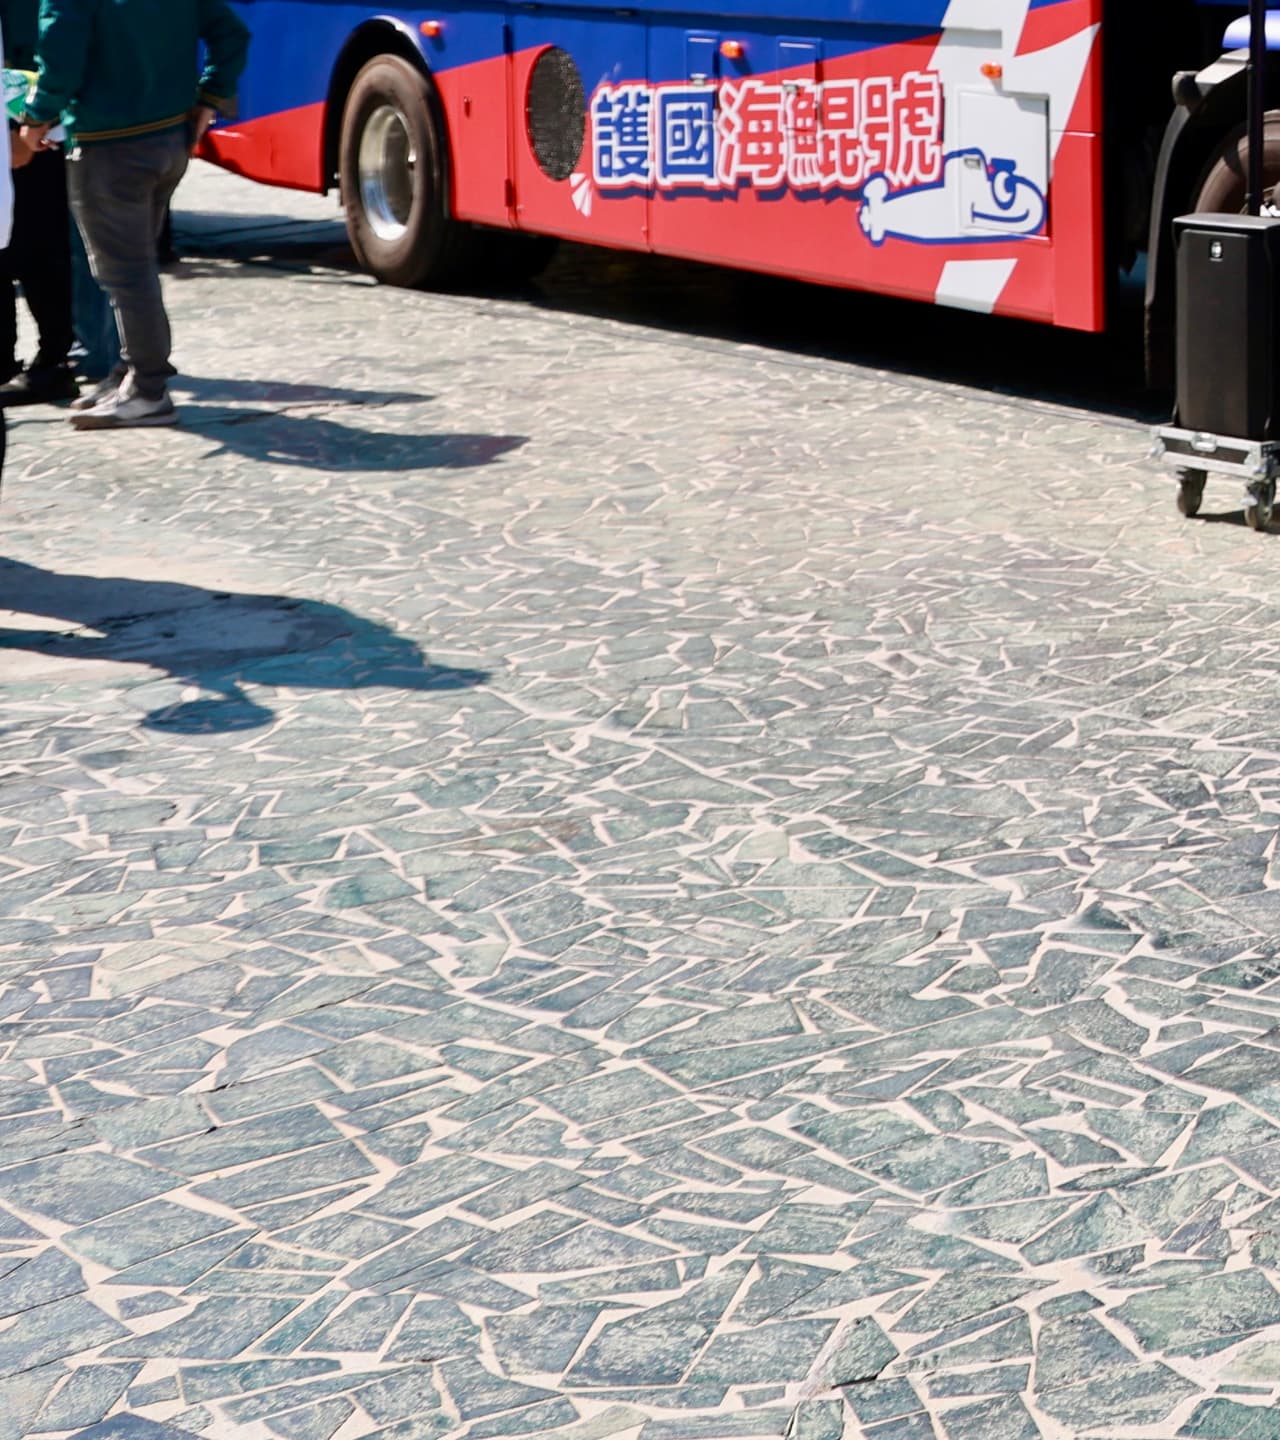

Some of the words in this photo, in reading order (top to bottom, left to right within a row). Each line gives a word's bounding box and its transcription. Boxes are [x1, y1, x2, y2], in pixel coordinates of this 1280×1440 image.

[592, 71, 942, 188] 護國海鯤號
